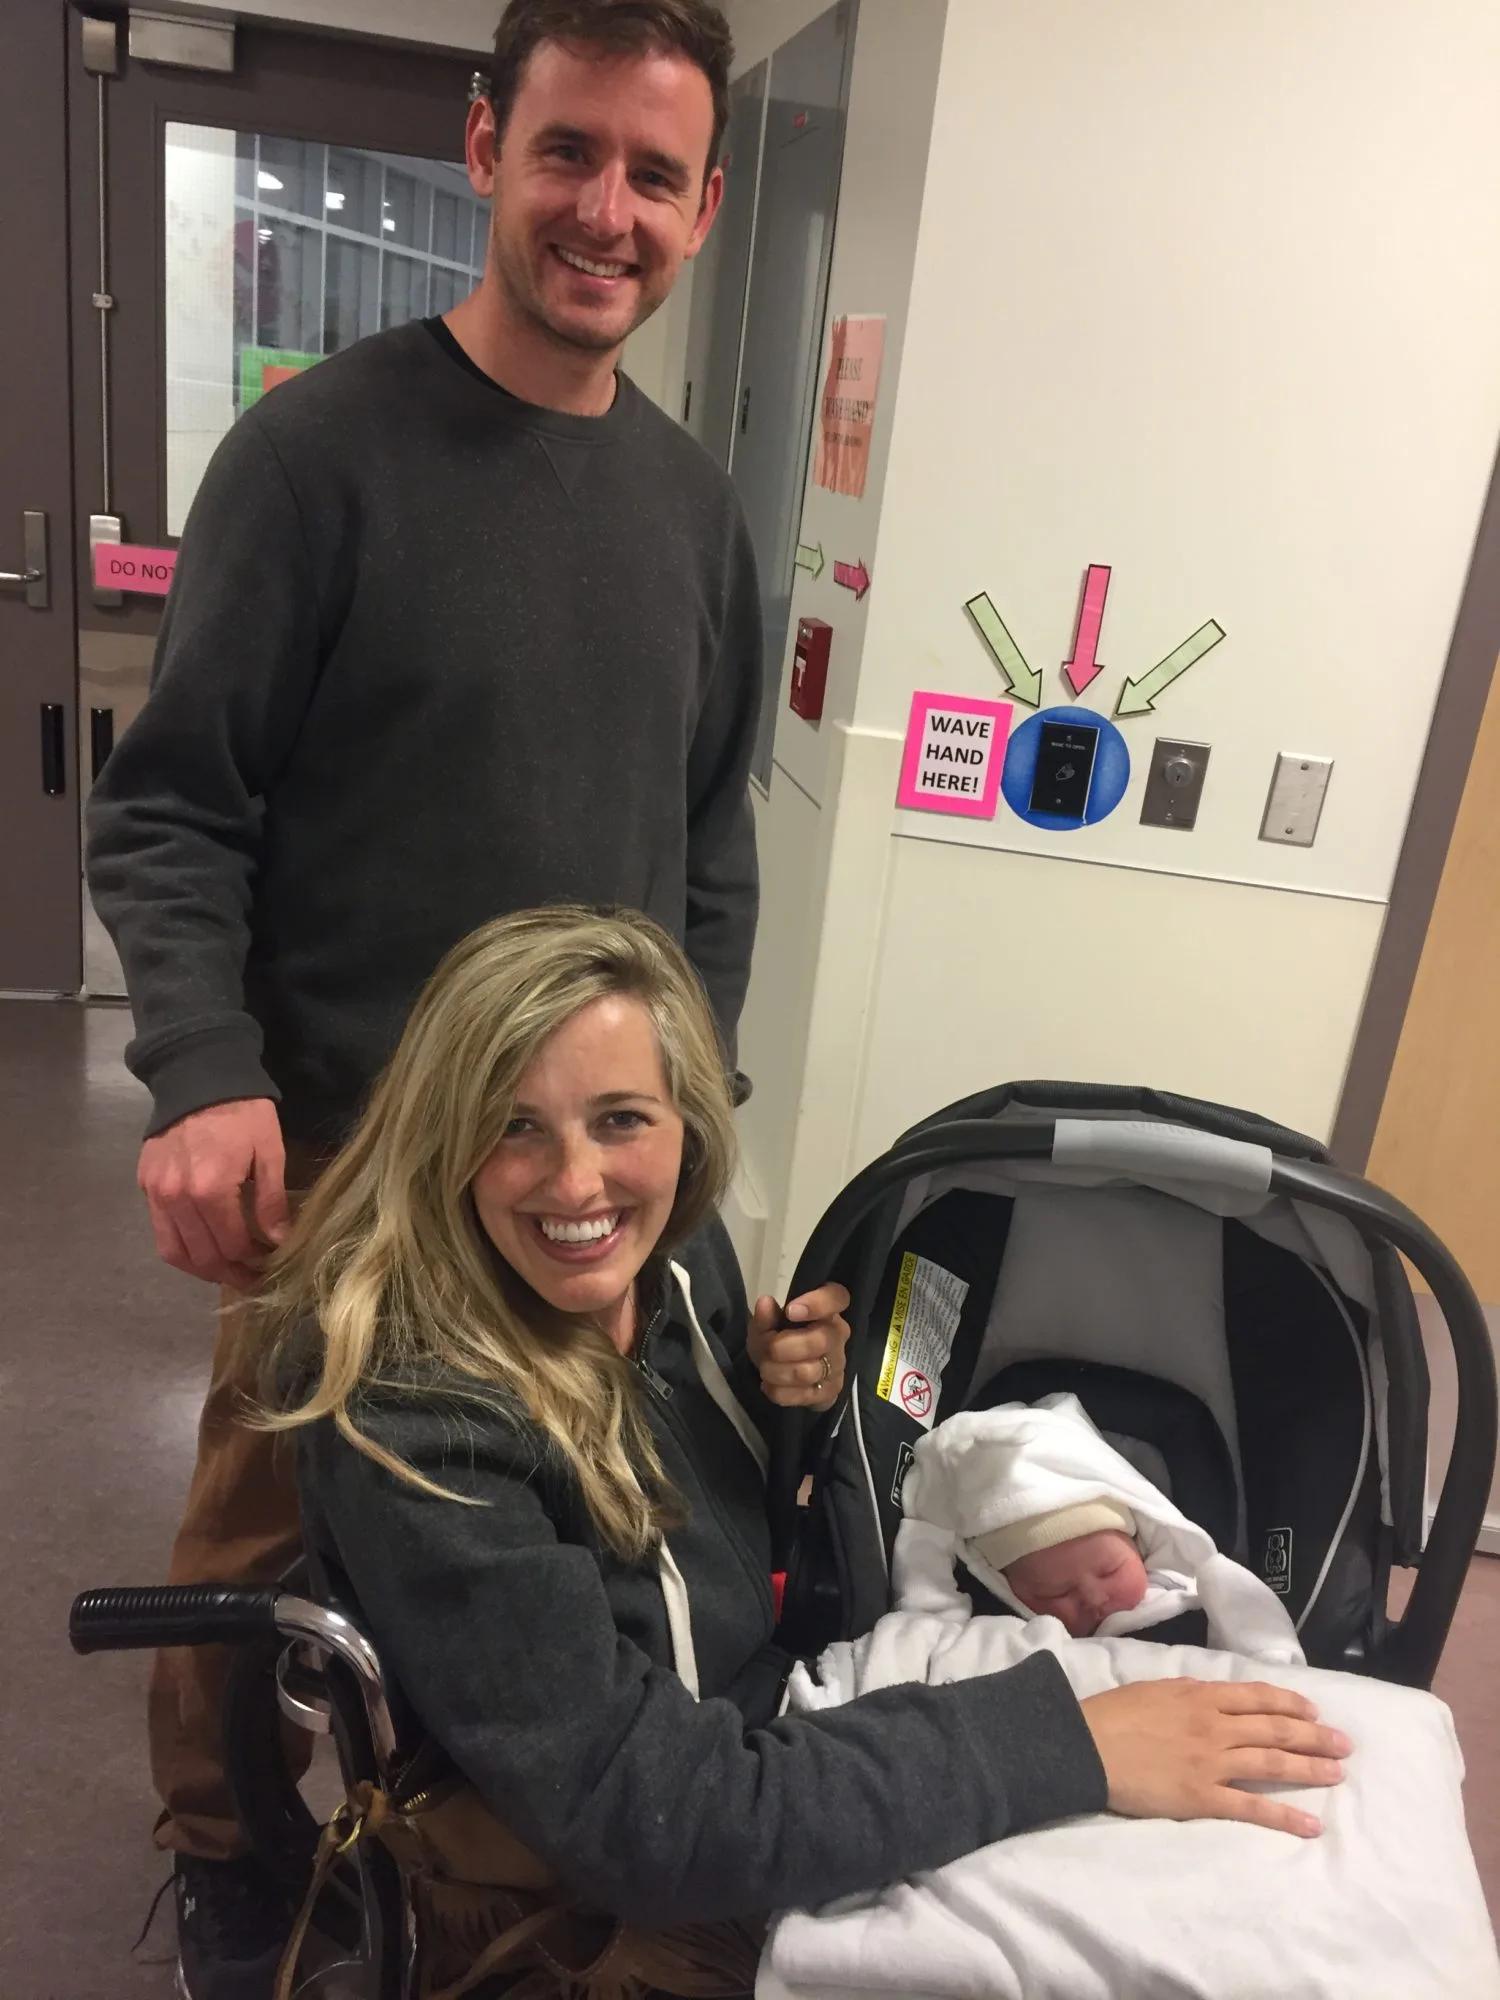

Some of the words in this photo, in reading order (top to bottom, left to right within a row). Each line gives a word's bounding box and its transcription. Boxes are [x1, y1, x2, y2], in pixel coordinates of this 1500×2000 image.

[111, 560, 136, 576] DO
[931, 715, 990, 739] WAVE
[926, 743, 984, 765] HAND
[922, 771, 978, 794] HERE!
[902, 1255, 914, 1284] GARDE
[898, 1286, 909, 1299] EN
[894, 1300, 907, 1322] MISE
[880, 1340, 898, 1387] WARNING
